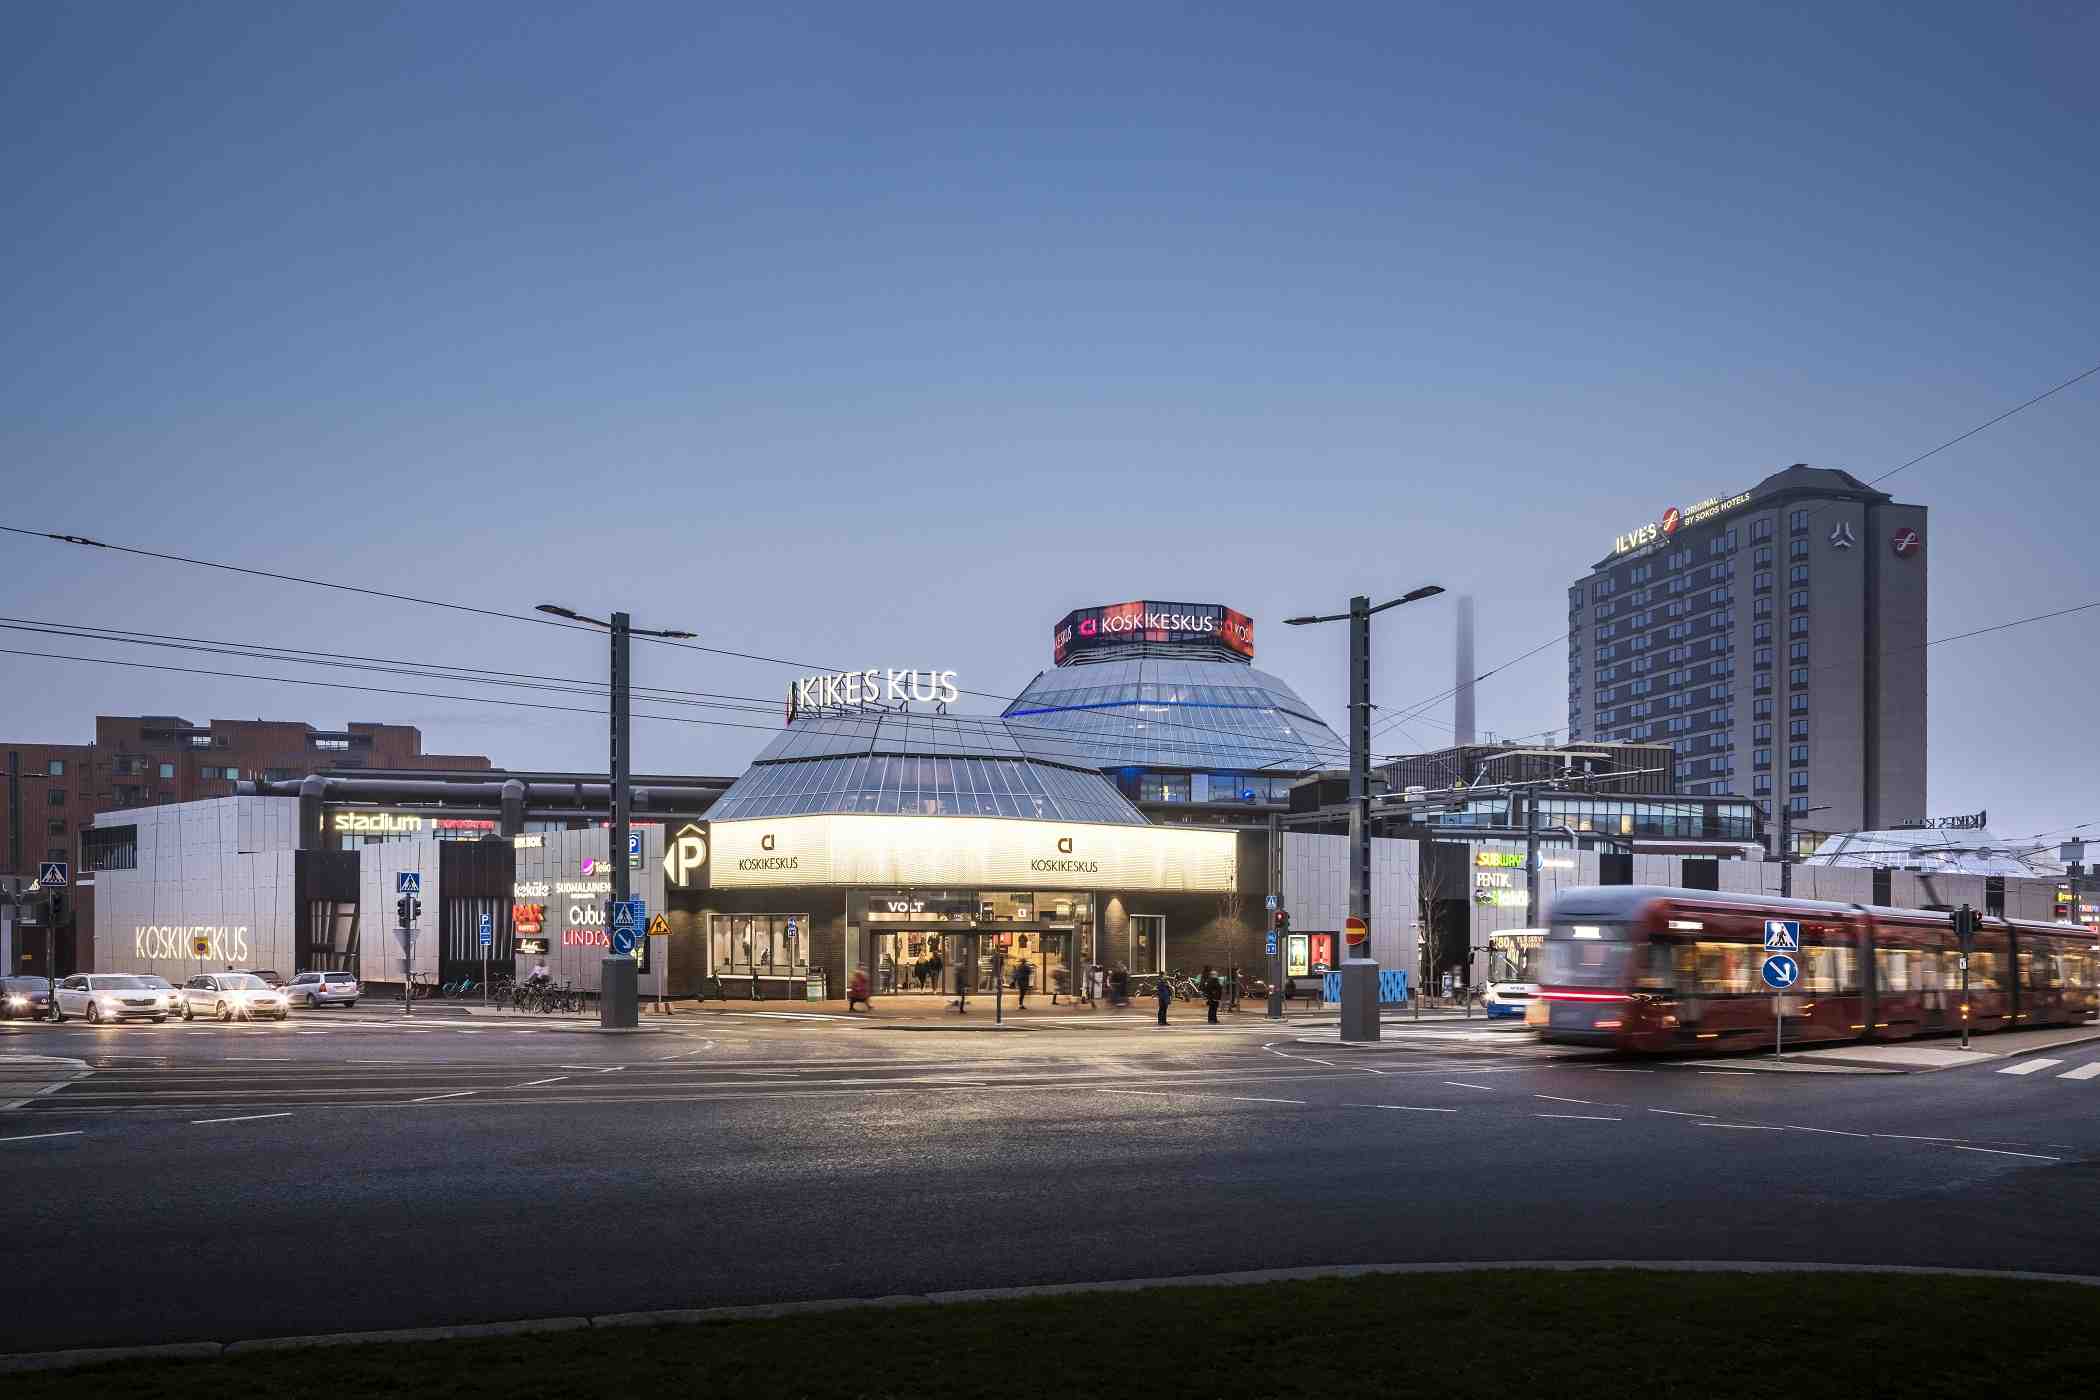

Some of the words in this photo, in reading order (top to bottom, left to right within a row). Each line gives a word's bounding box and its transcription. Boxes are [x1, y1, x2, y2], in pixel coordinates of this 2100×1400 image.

[1684, 496, 1719, 516] ORIGINAL
[1684, 512, 1695, 527] BY
[1695, 505, 1720, 522] SOKOS
[1721, 492, 1750, 512] HOTELS
[1615, 523, 1658, 554] ILVES
[1102, 613, 1214, 633] KOSKIKESKUS
[335, 812, 422, 832] stadium
[677, 836, 707, 887] P
[739, 856, 799, 871] KOSKIKESKUS
[1031, 859, 1098, 873] KOSKIKESKUS
[1475, 852, 1521, 868] SUBWAY
[887, 901, 924, 913] VOLT
